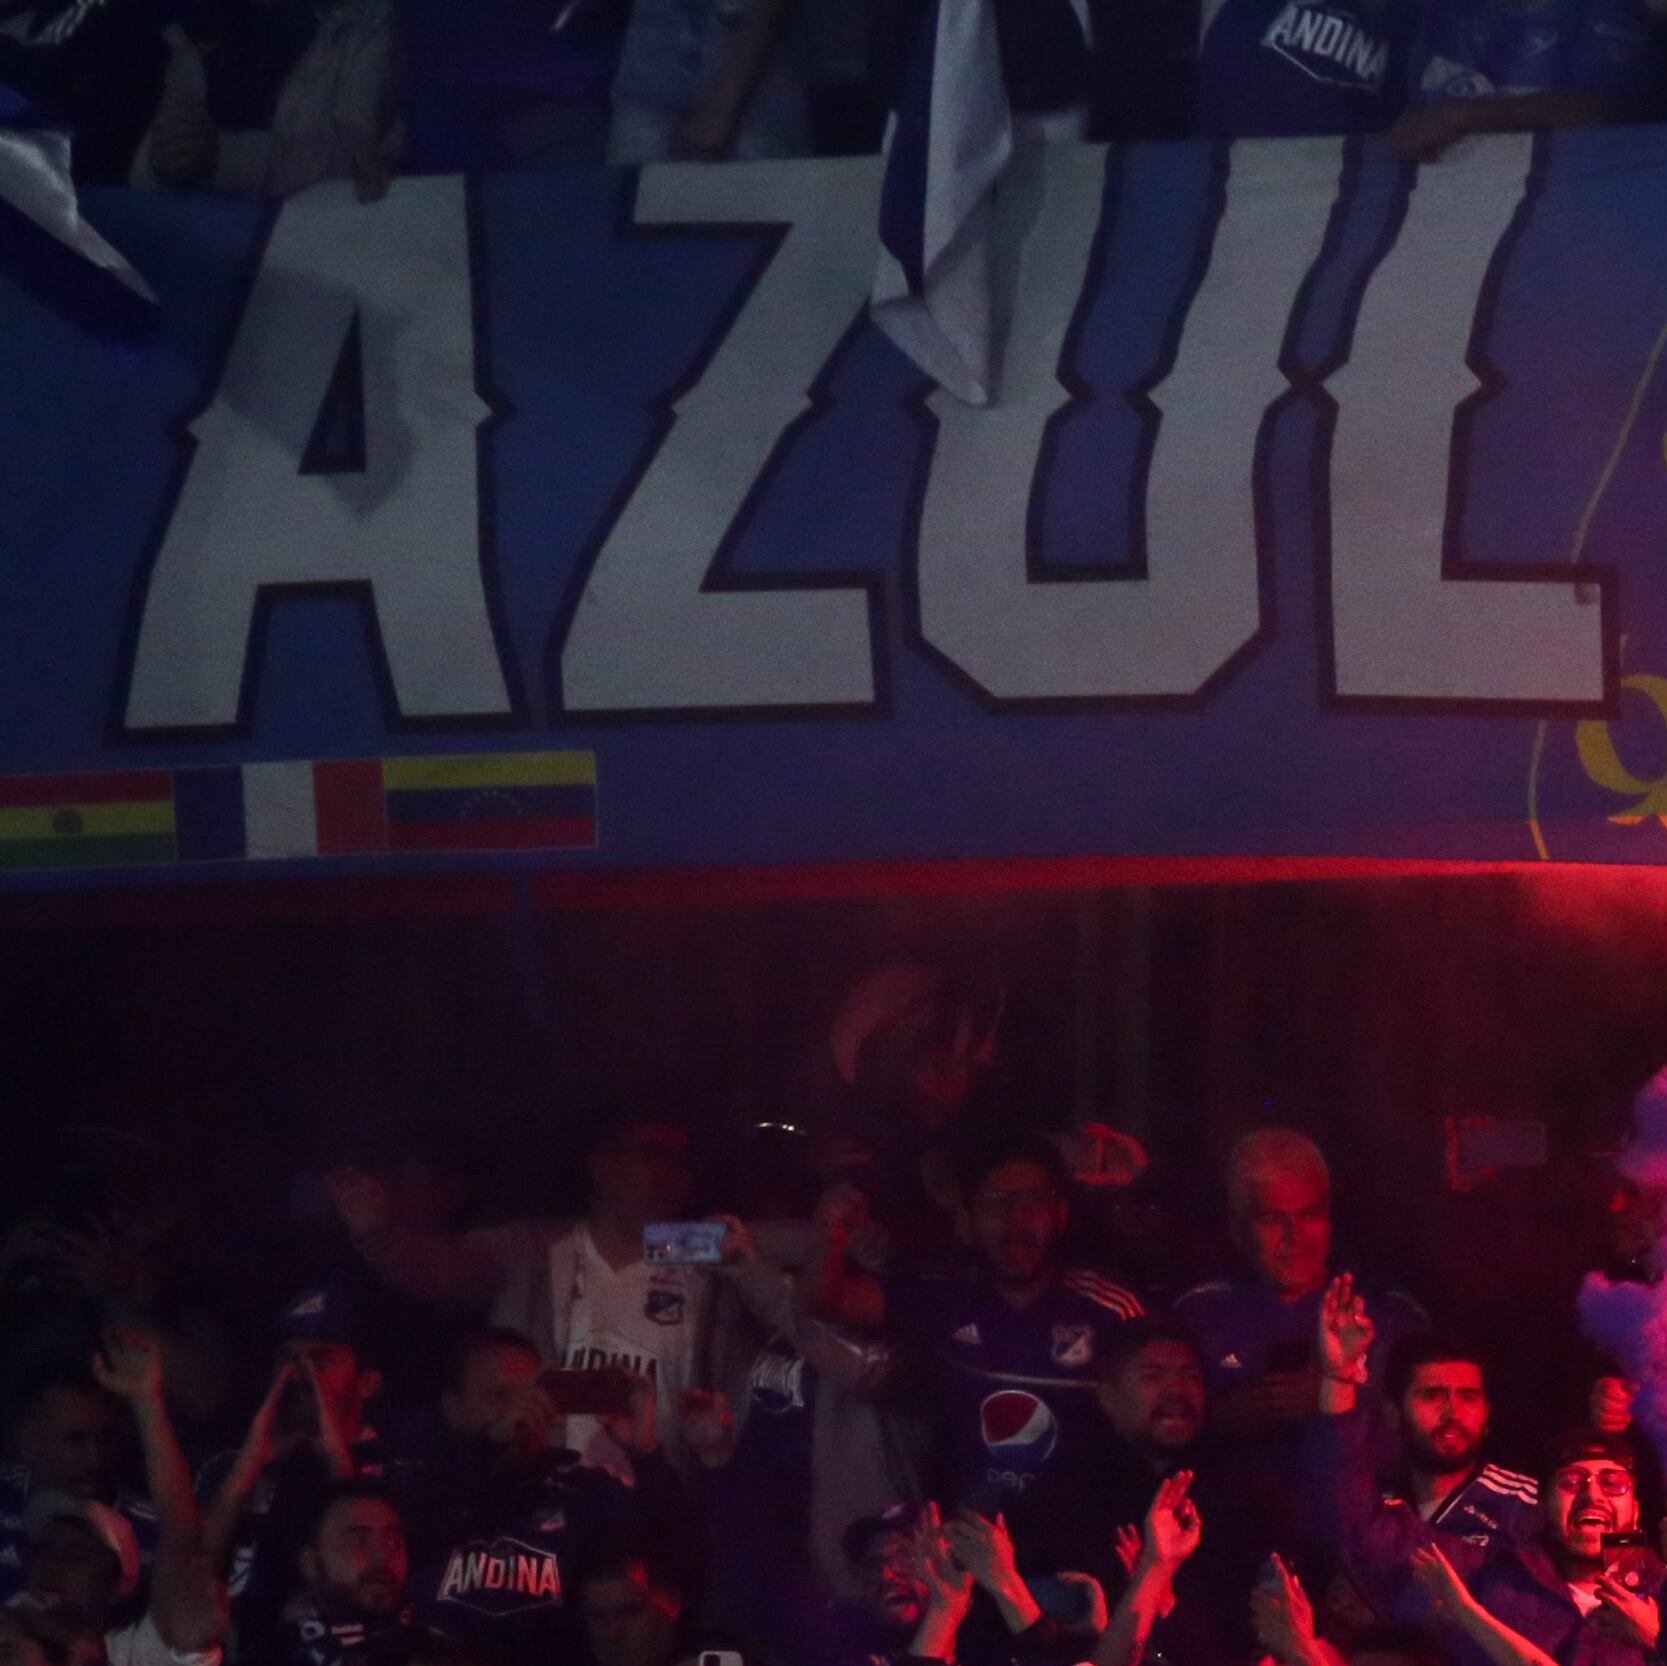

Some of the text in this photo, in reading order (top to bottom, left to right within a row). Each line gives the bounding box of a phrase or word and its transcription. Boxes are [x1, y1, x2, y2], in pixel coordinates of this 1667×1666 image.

[1262, 3, 1389, 82] ANDINA
[122, 132, 1612, 745] AZUL
[437, 1548, 564, 1602] ANDINA
